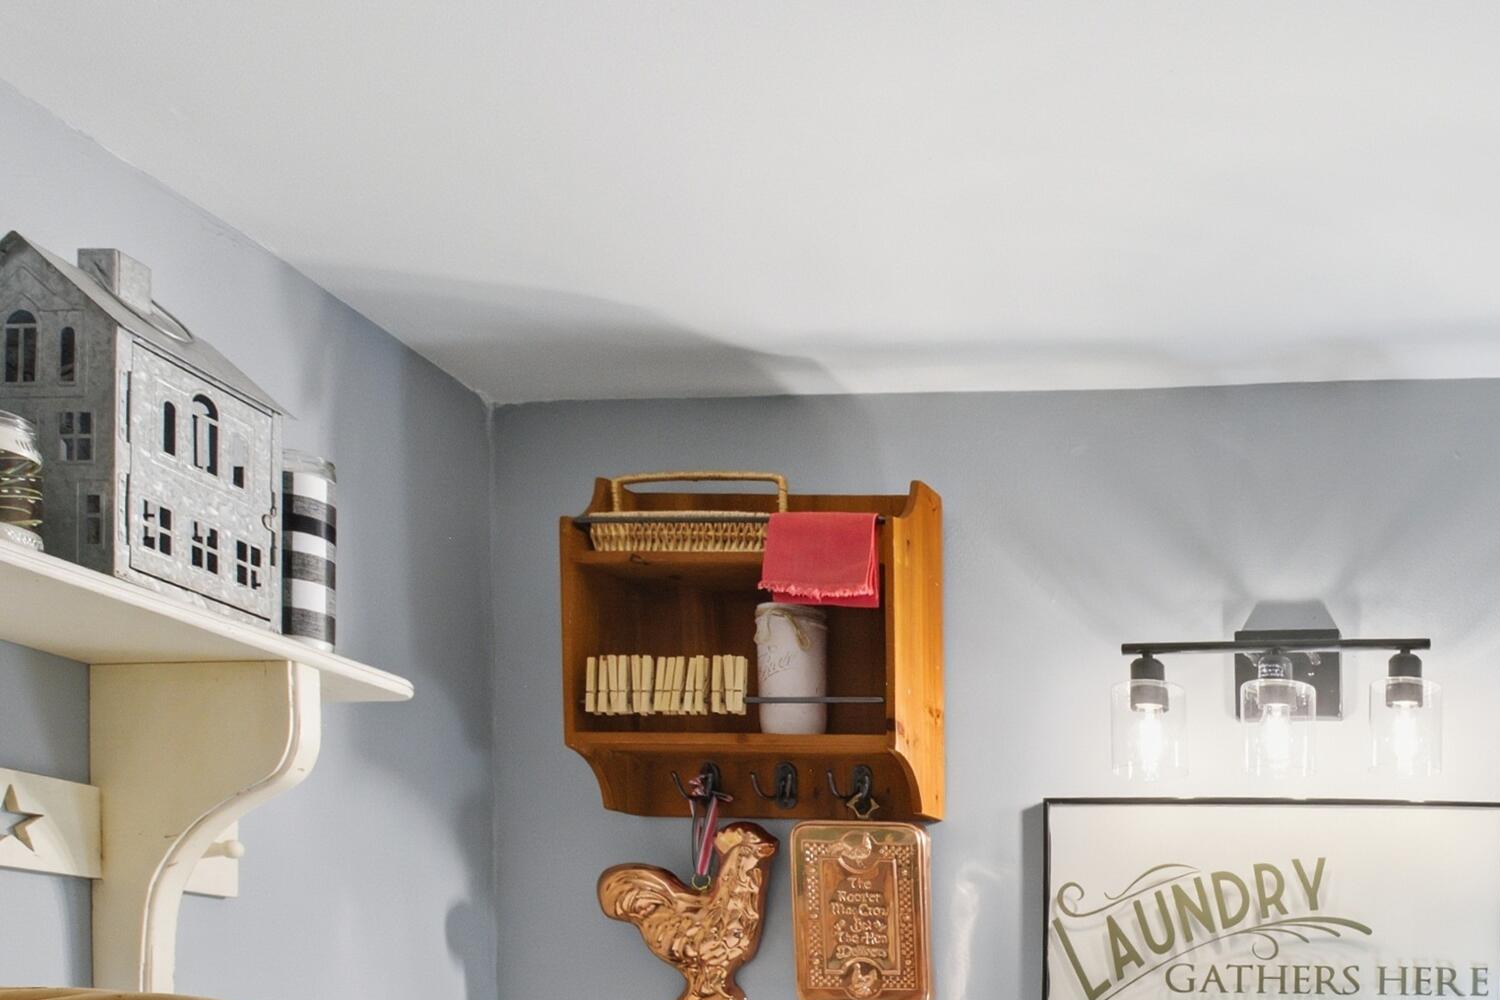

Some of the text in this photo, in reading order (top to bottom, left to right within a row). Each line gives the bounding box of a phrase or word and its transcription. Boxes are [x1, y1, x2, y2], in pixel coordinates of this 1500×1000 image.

[846, 877, 872, 889] The
[835, 931, 888, 945] The Hen
[1165, 963, 1489, 997] GATHERS HERE
